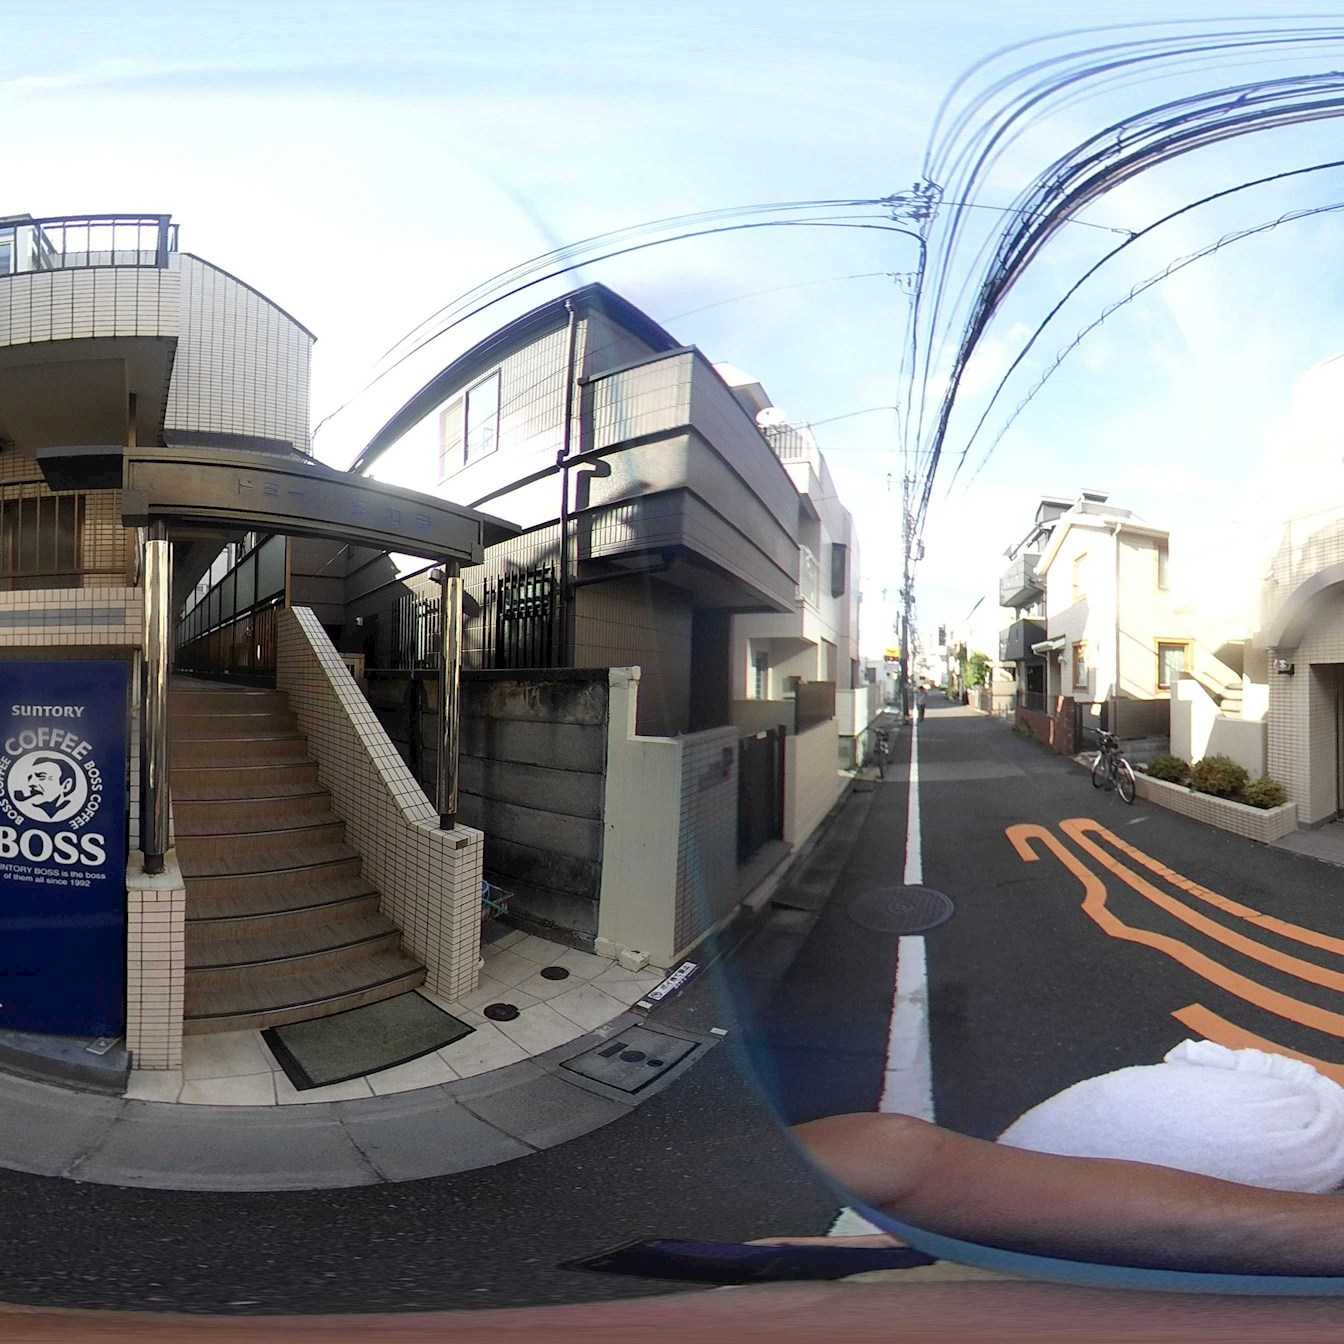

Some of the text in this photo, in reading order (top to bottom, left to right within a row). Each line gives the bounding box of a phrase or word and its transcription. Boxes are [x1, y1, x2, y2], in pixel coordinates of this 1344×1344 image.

[5, 727, 93, 760] COFFEE
[68, 760, 103, 830] BOSS COFFEE
[3, 872, 11, 880] of
[13, 874, 34, 882] them
[35, 875, 45, 883] all
[46, 876, 68, 886] since
[34, 867, 60, 877] BOSS
[61, 870, 69, 878] is
[70, 871, 83, 879] the
[85, 871, 106, 880] boss
